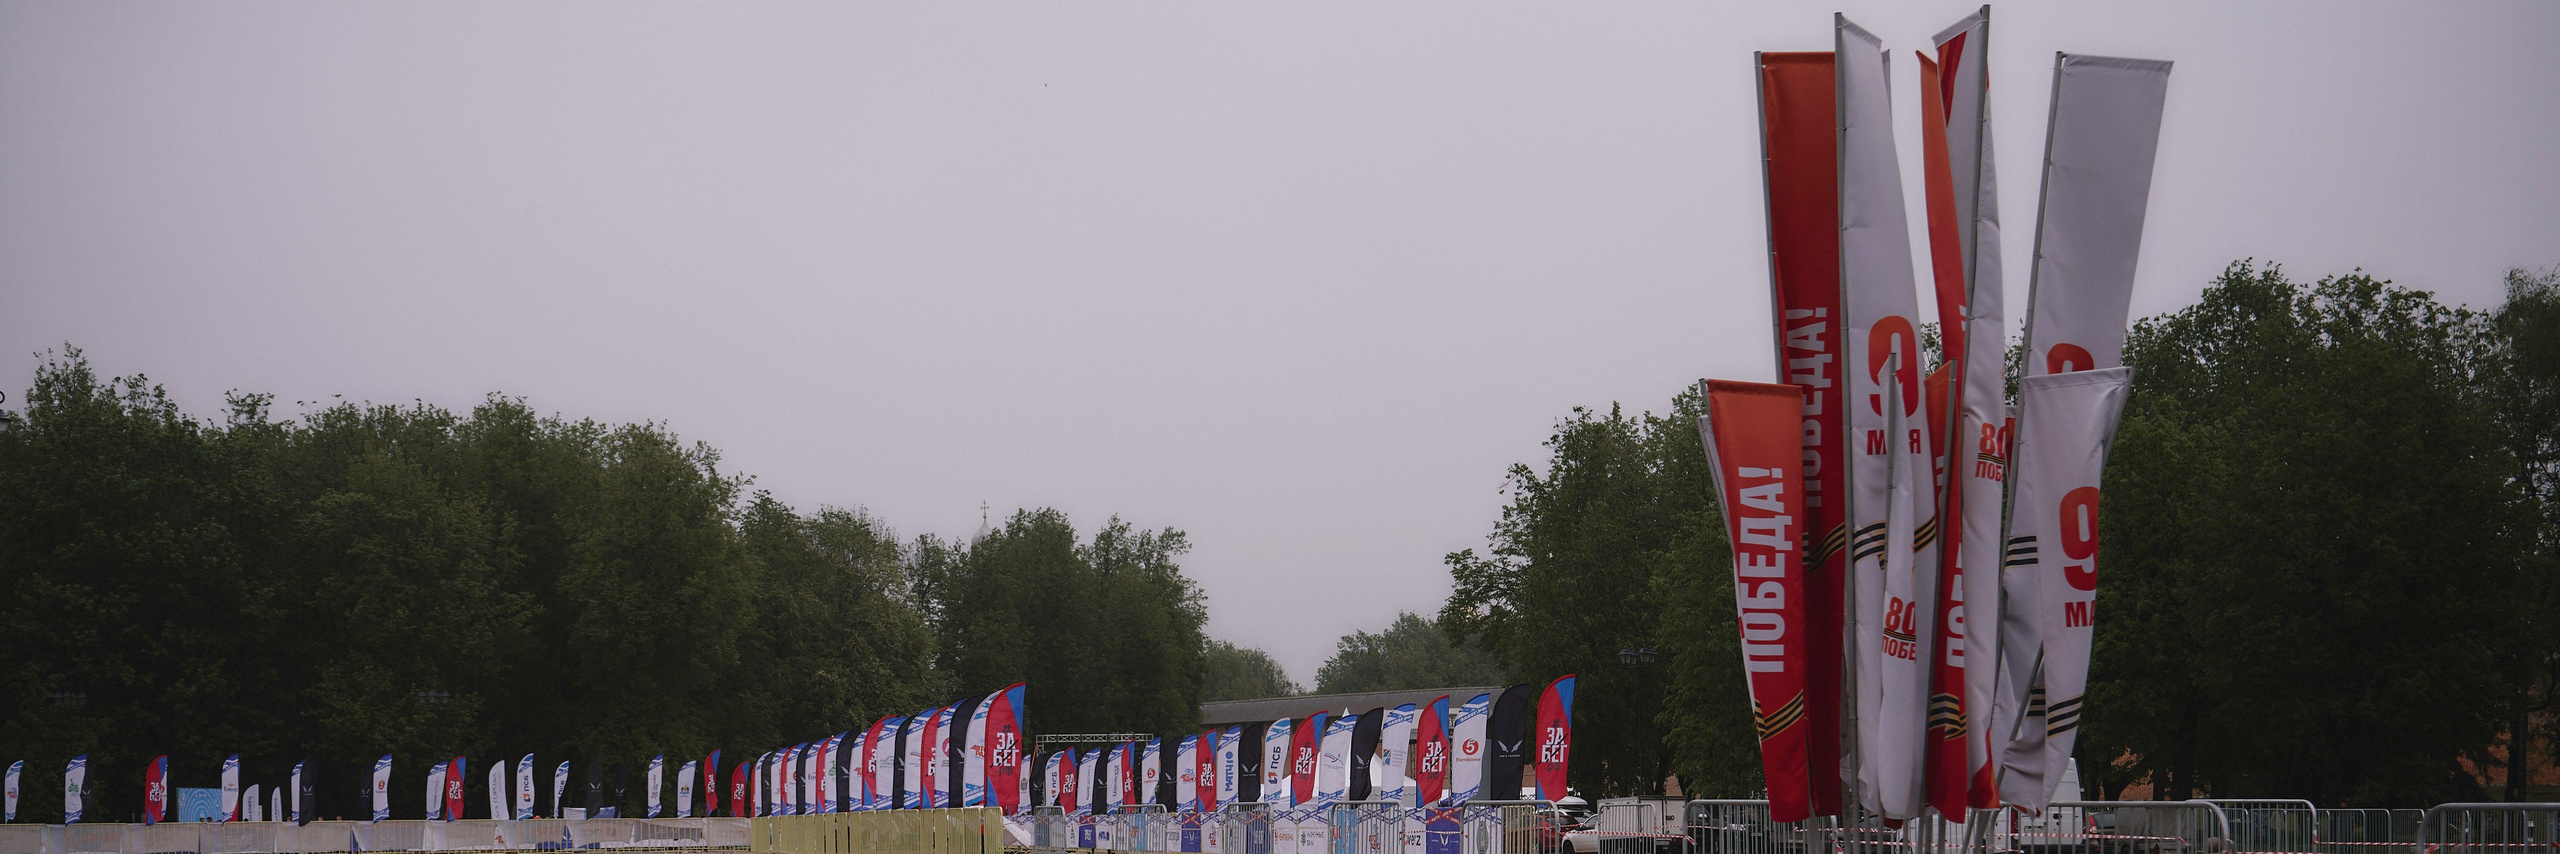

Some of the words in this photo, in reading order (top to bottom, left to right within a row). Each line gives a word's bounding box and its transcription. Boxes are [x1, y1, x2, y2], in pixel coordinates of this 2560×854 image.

[1868, 315, 1920, 419] 9
[1866, 428, 1921, 455] МЯ
[1974, 460, 2005, 484] ПОБ
[2059, 486, 2101, 591] 9
[1738, 466, 1793, 673] ПОБЕДА!
[996, 732, 1016, 750] ЗА
[1546, 727, 1565, 746] ЗА
[993, 749, 1020, 767] БЕГ
[1270, 746, 1281, 769] ПСБ
[1299, 747, 1313, 761] ЗА
[1426, 741, 1443, 758] ЗА
[1541, 744, 1568, 763] БЕГ
[1295, 760, 1314, 775] БЕГ
[1422, 756, 1446, 773] БЕГ
